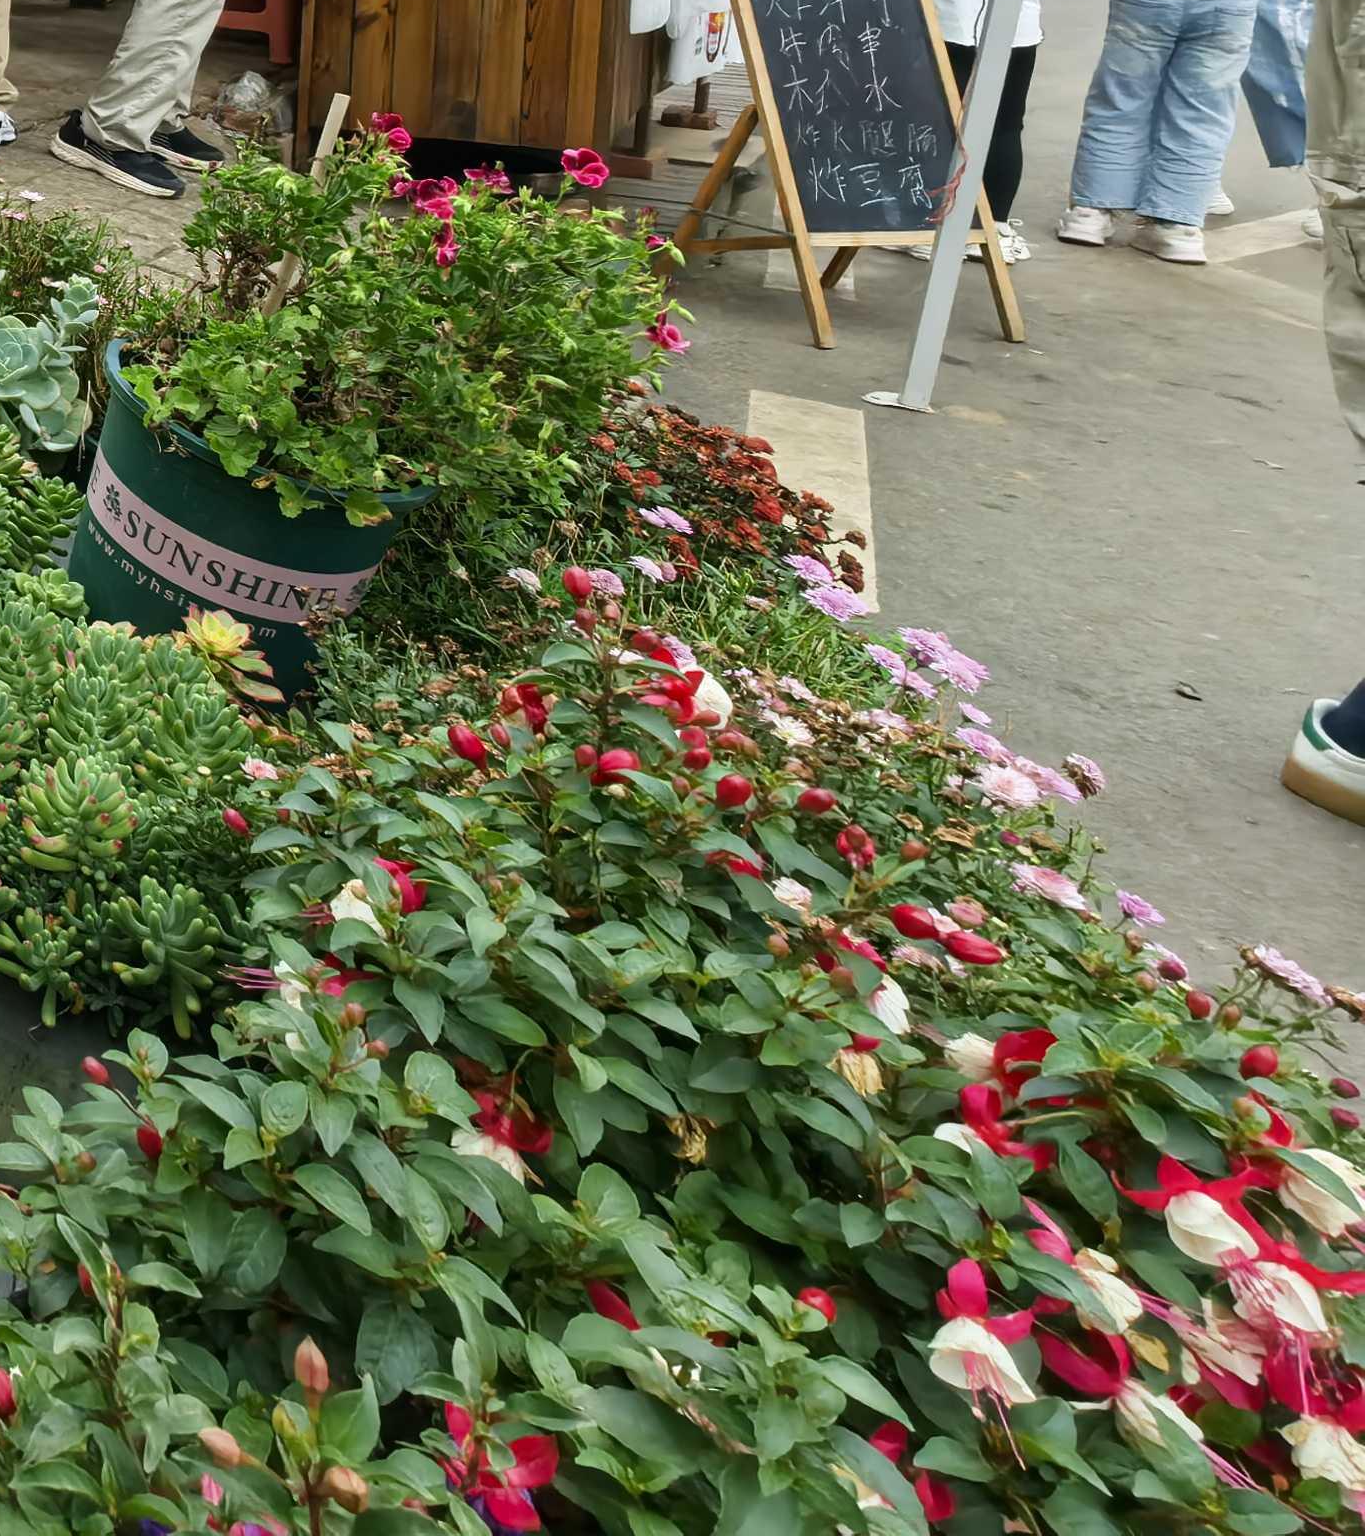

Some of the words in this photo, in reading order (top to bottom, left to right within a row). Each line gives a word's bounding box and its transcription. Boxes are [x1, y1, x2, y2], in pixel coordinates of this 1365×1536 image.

[808, 157, 933, 210] 炸豆腐
[123, 510, 338, 611] SUNSHINE
